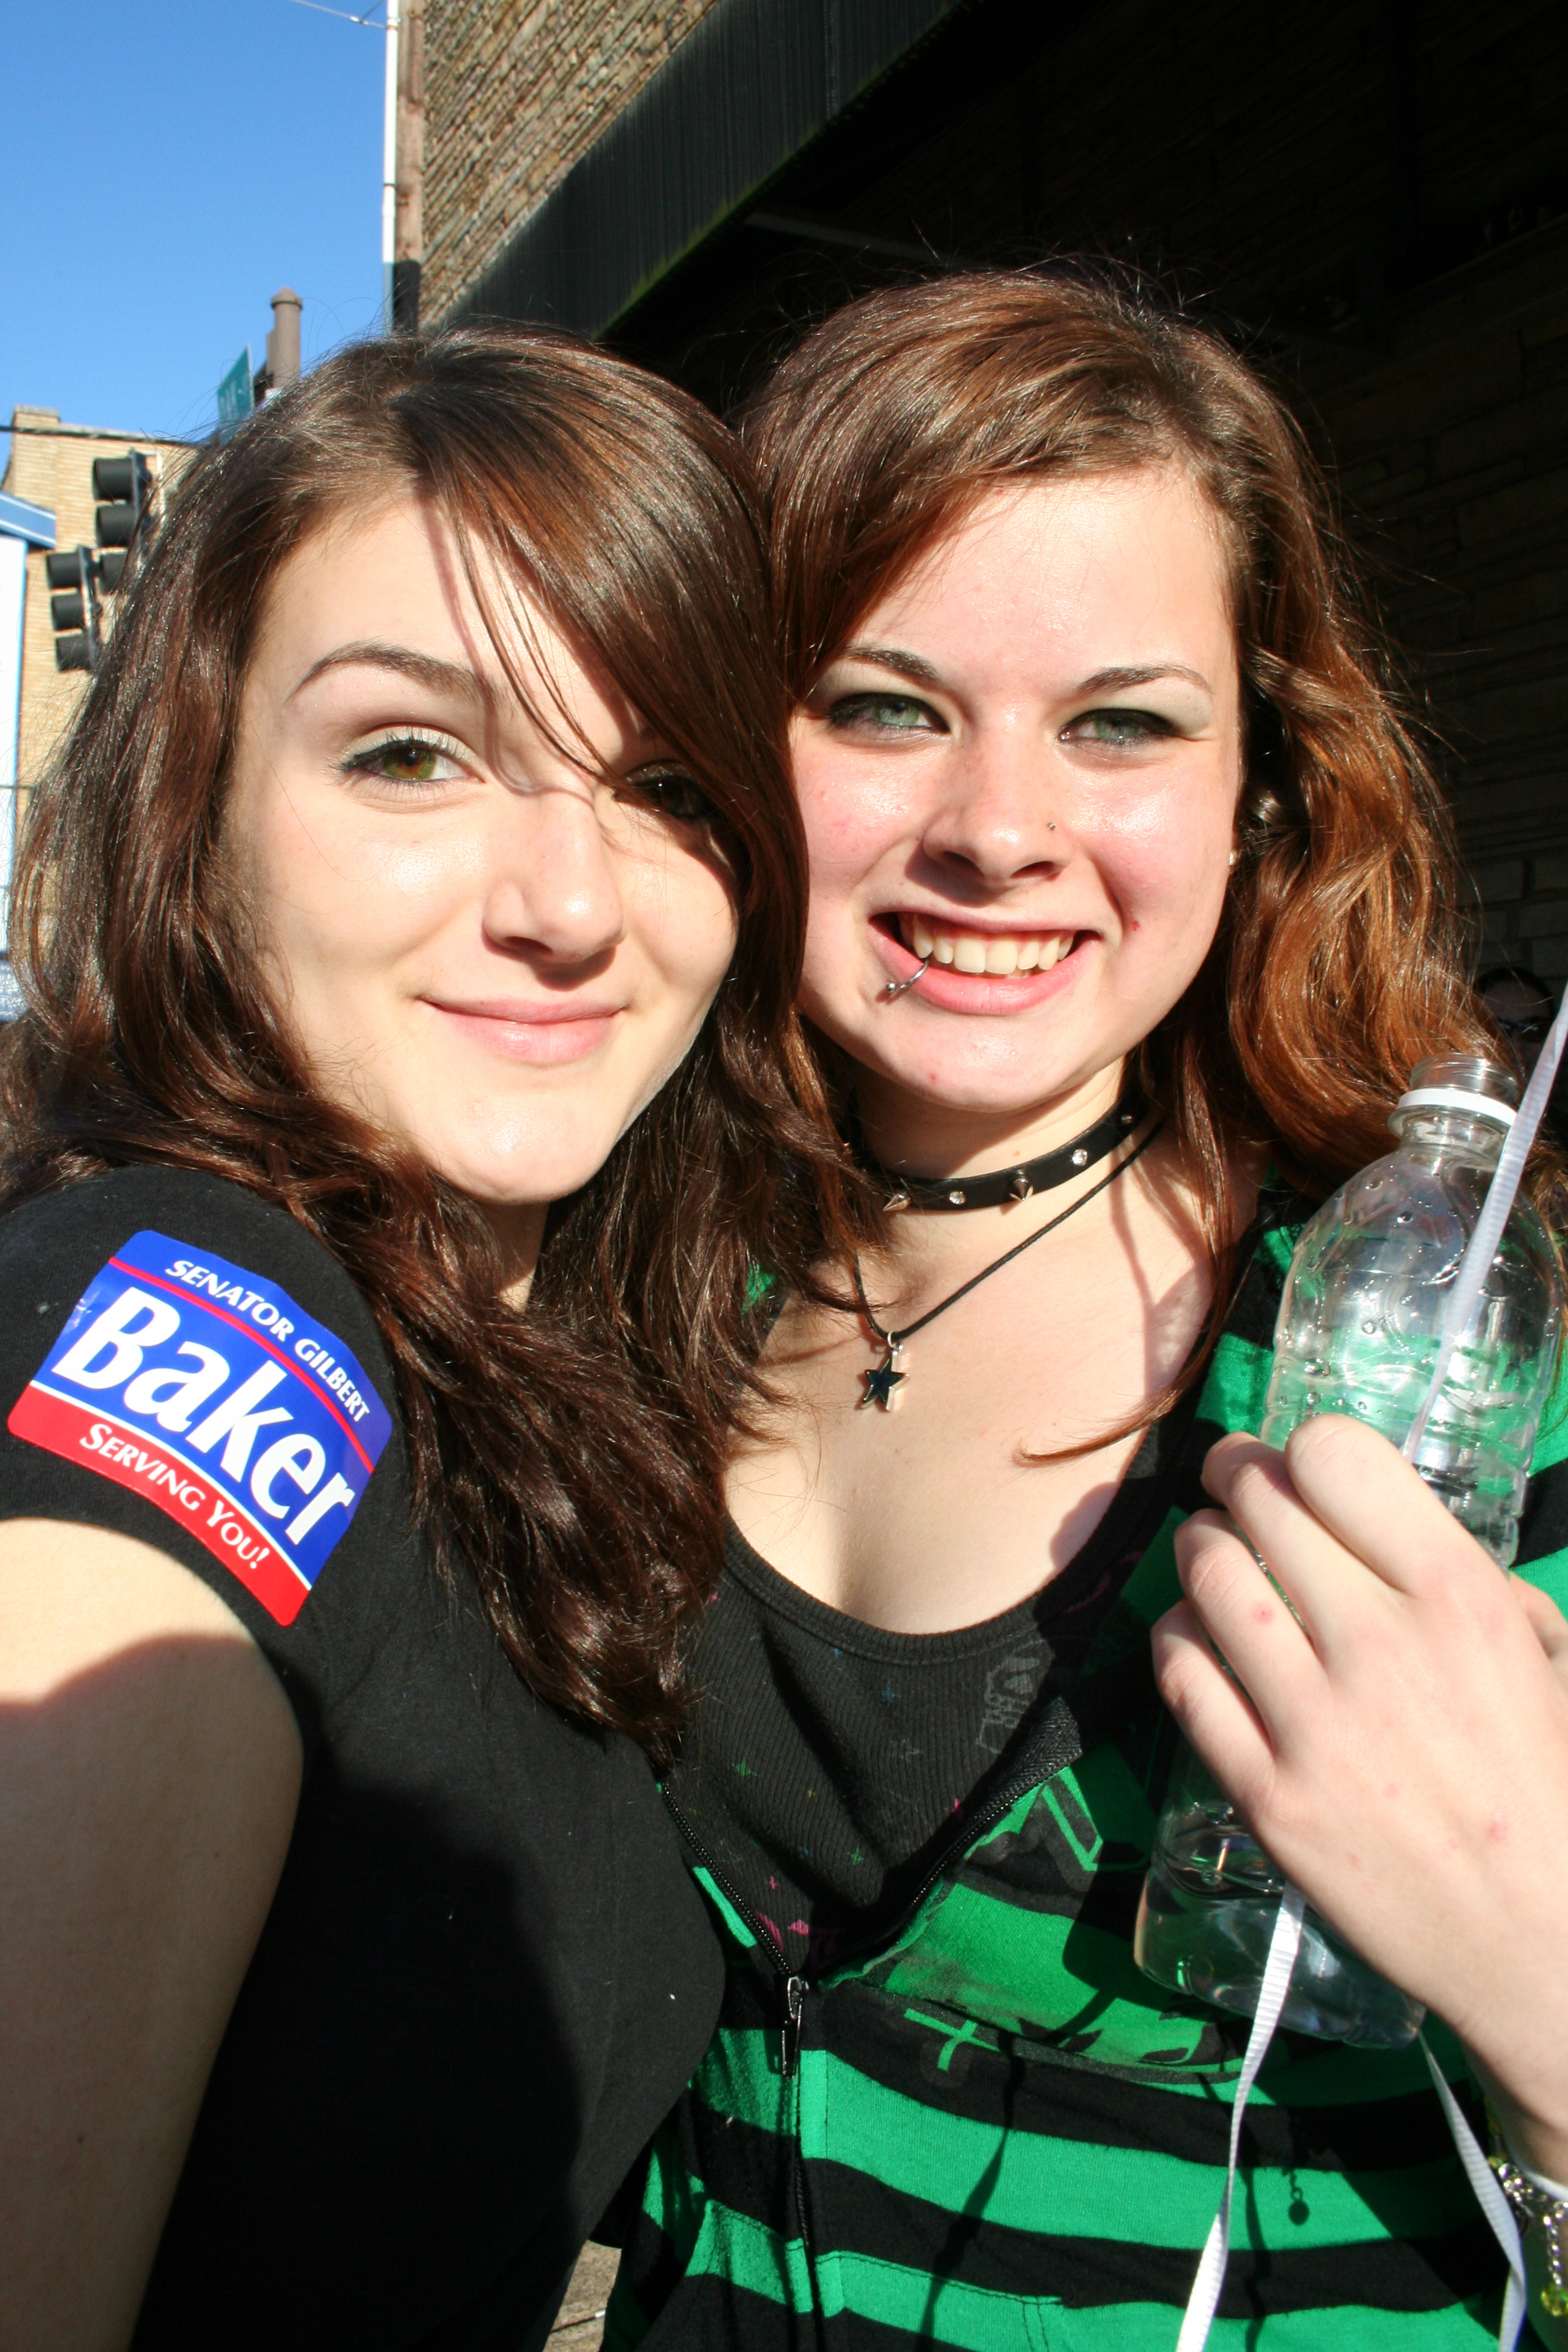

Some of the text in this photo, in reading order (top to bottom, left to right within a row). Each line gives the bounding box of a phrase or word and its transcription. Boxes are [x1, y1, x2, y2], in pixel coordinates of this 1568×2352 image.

[51, 1287, 355, 1546] Baker
[165, 1259, 370, 1422] SENATOR GILBERT
[80, 1423, 270, 1569] SERVING YOU!
